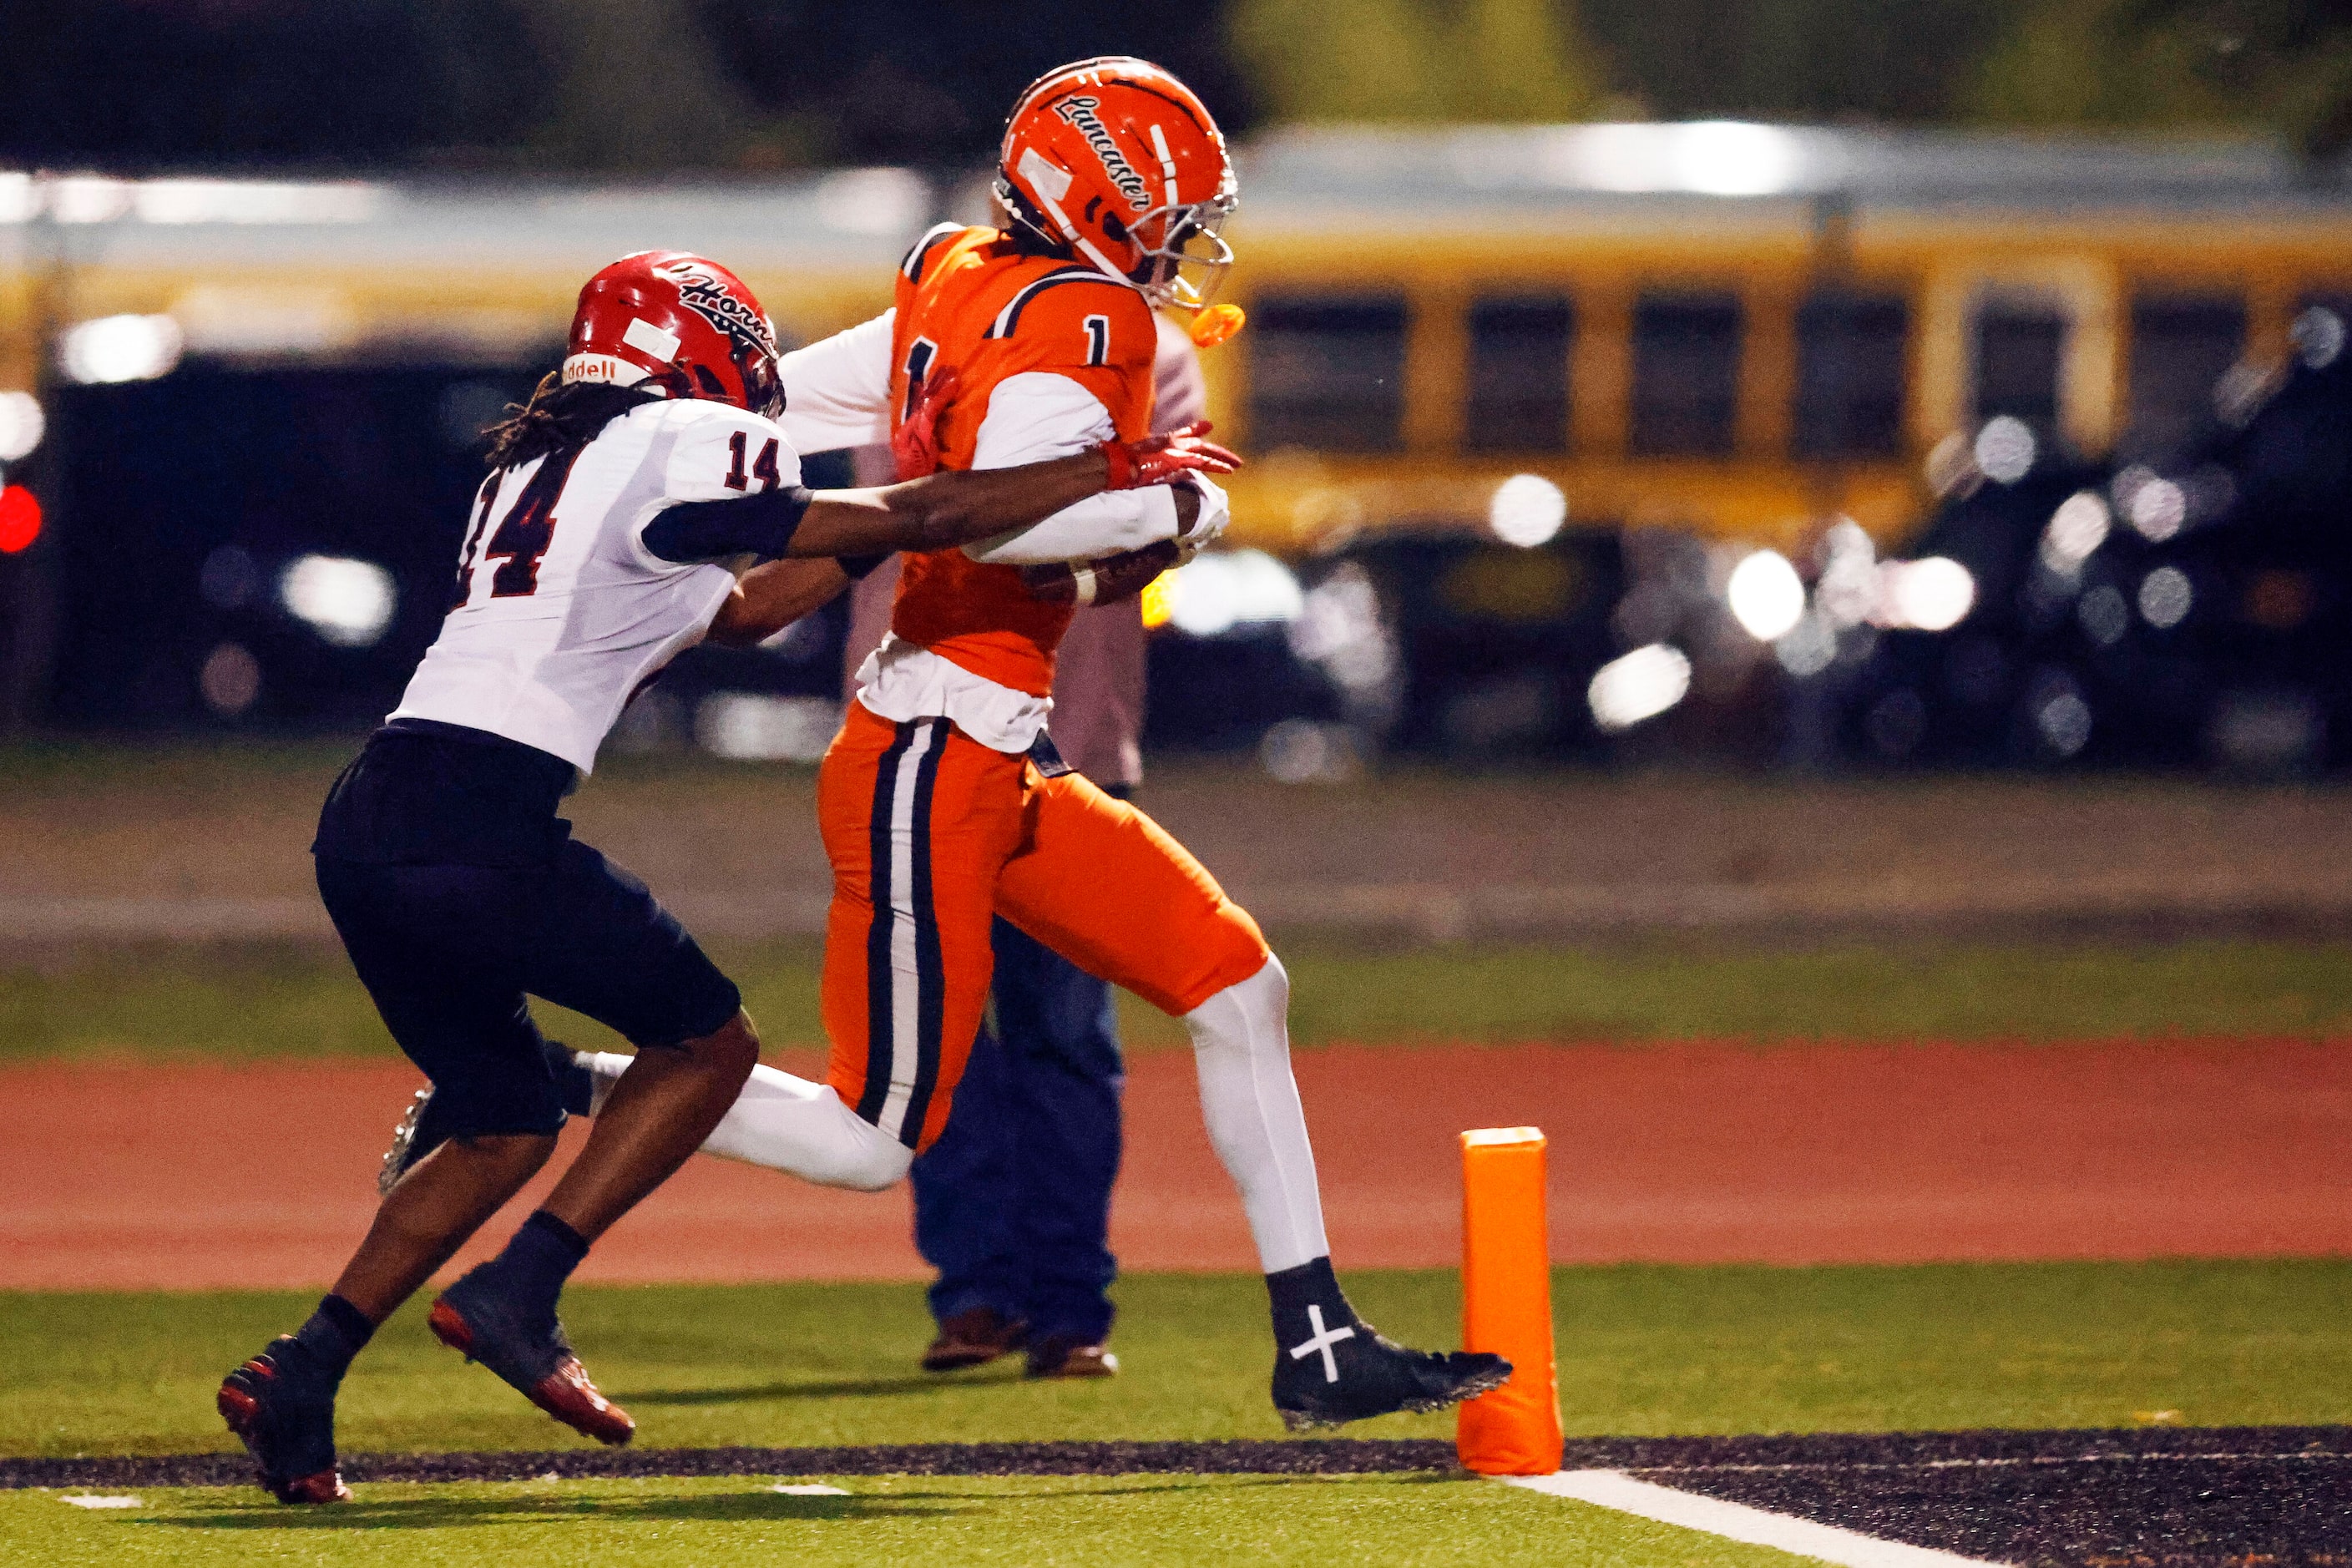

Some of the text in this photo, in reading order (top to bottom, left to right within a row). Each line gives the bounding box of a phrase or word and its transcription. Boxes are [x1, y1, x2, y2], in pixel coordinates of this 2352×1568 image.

[1053, 96, 1151, 210] Lancaster
[680, 273, 772, 341] Horn
[1083, 314, 1110, 366] 1
[565, 360, 615, 379] ddell
[901, 336, 938, 426] 1
[724, 431, 781, 492] 14
[450, 444, 589, 615] 14
